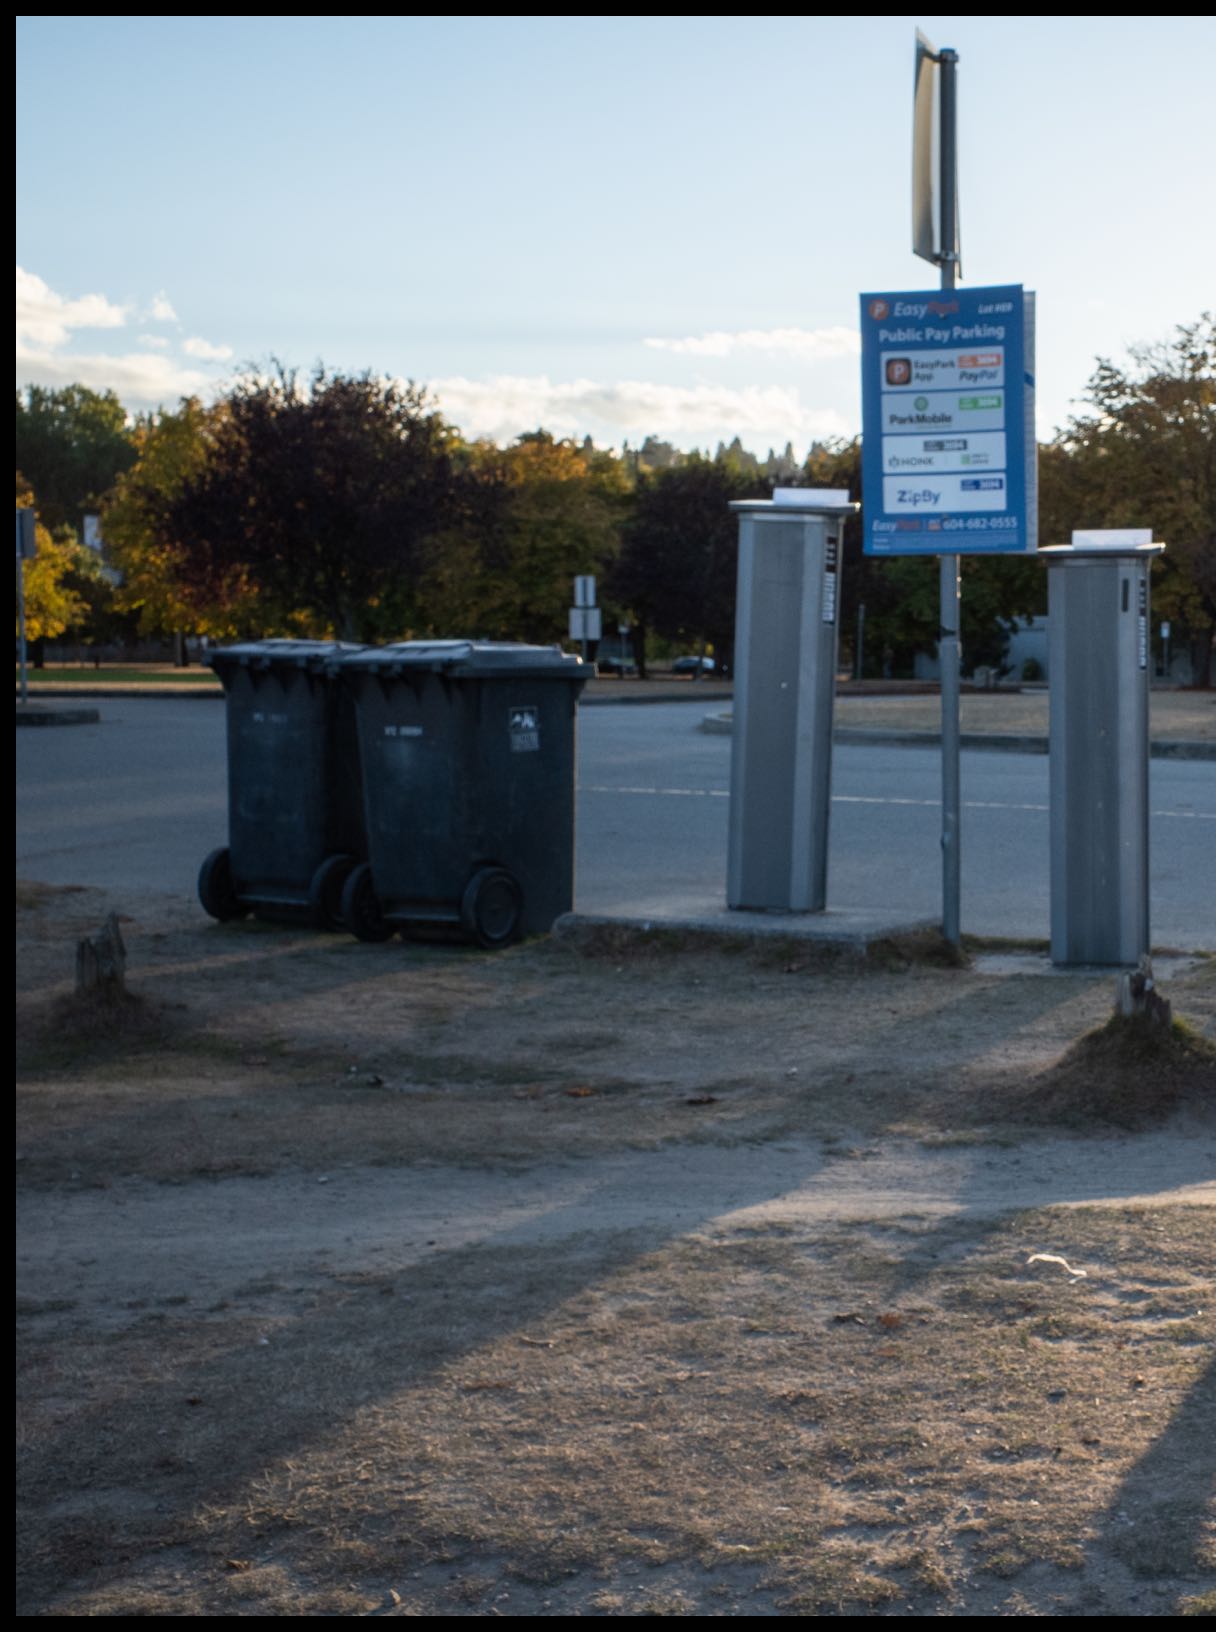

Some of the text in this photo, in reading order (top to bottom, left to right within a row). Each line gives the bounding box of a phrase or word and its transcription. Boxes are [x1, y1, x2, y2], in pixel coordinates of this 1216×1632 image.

[879, 324, 1006, 343] Public Pay Parking
[914, 359, 955, 371] EasyPark
[914, 372, 934, 383] App
[959, 369, 999, 383] PayPal
[889, 412, 952, 425] ParkMobile
[897, 489, 941, 506] ZipBy
[872, 519, 921, 532] Easy
[943, 516, 1017, 530] 604-682-0555
